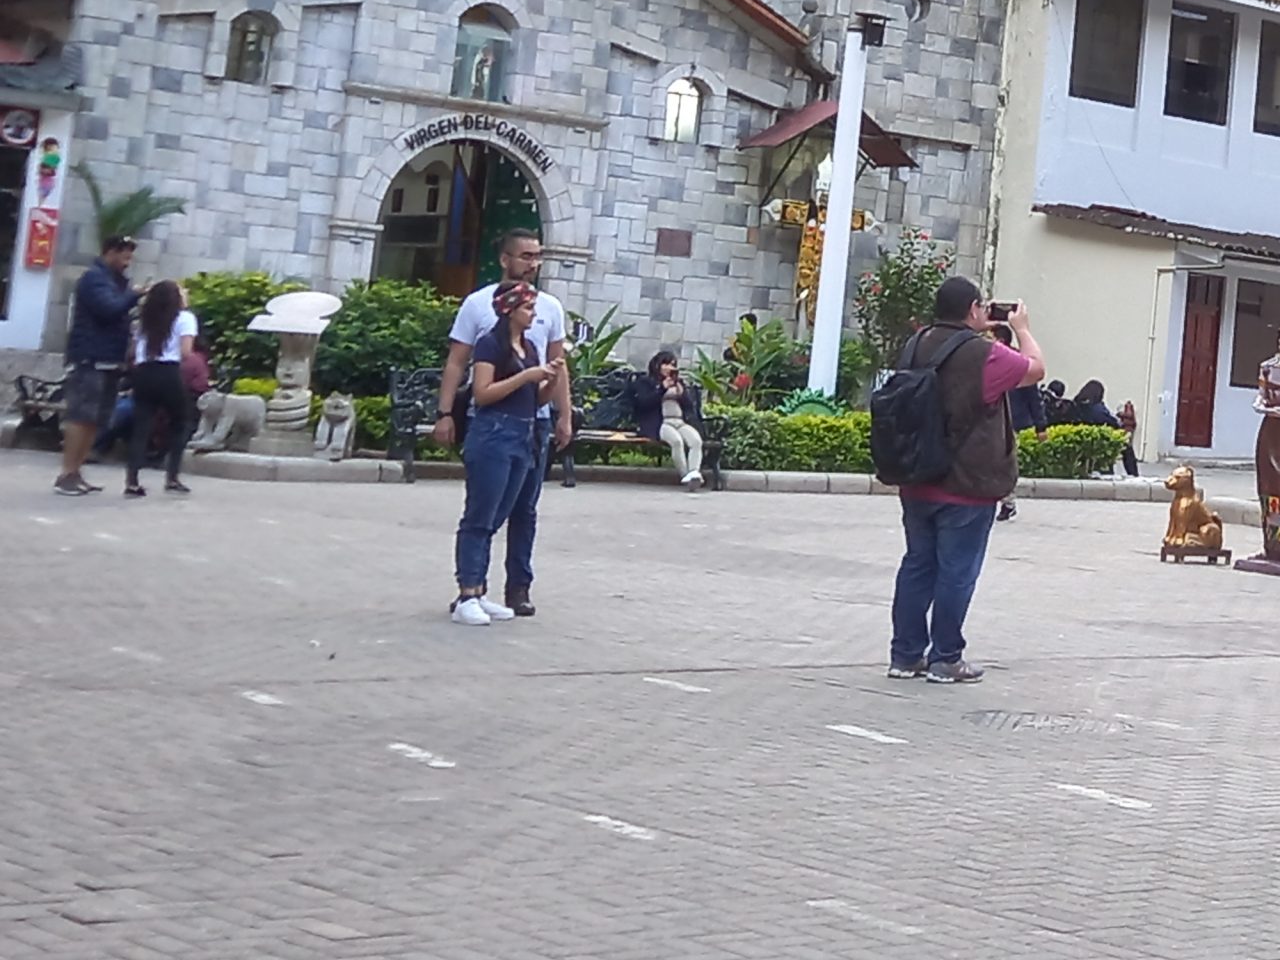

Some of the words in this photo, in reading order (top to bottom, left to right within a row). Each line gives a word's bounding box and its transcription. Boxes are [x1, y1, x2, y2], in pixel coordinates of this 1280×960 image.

[404, 117, 458, 150] VIRGEN
[464, 114, 494, 131] DEL
[496, 121, 554, 174] CARMEN
